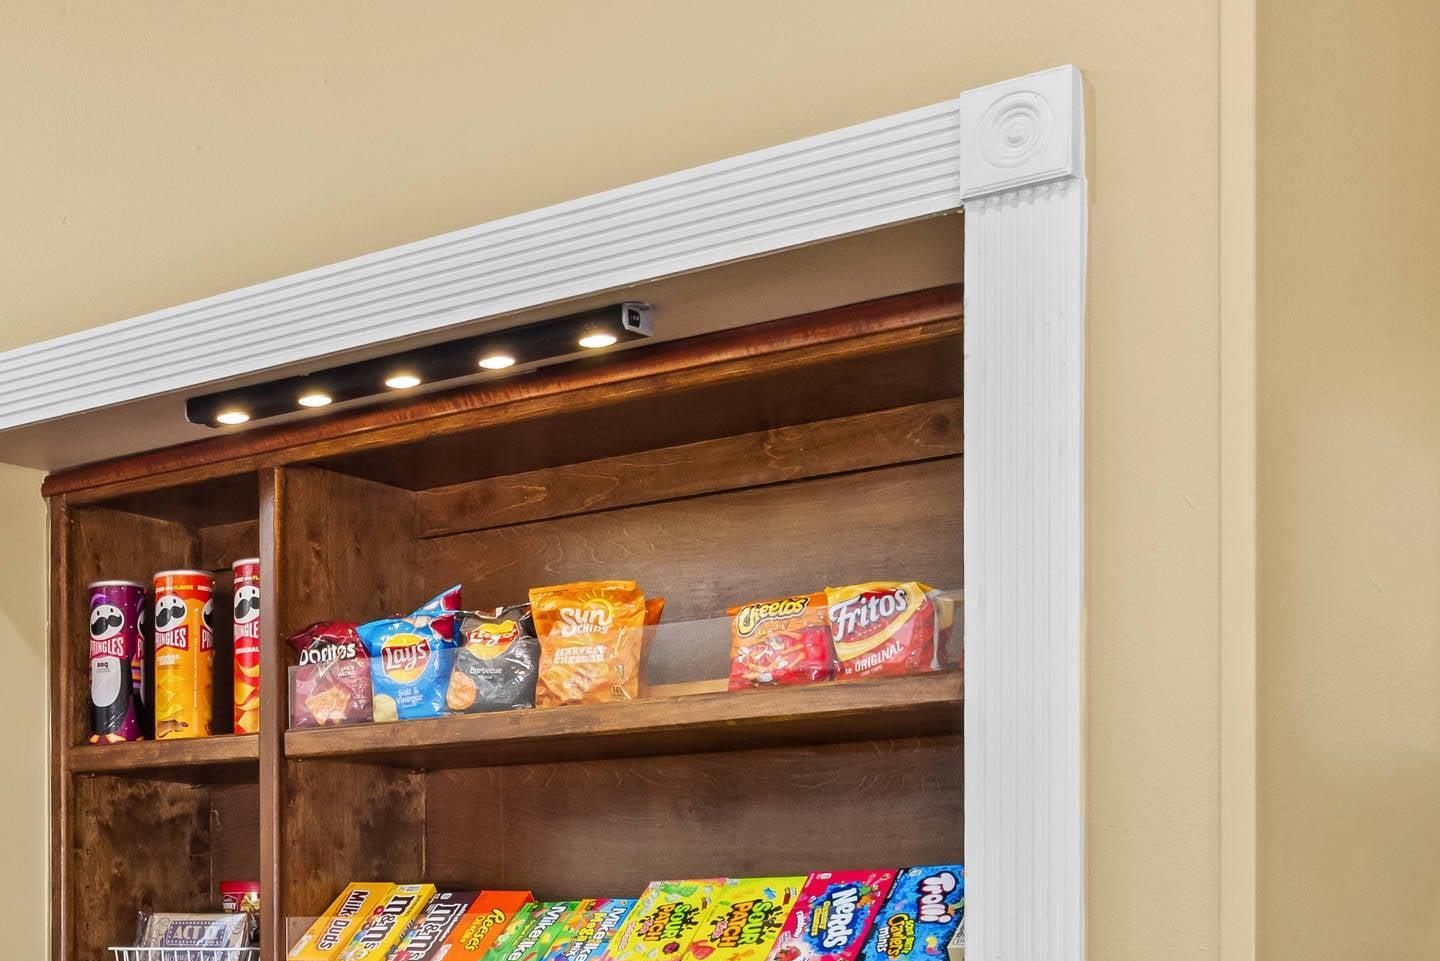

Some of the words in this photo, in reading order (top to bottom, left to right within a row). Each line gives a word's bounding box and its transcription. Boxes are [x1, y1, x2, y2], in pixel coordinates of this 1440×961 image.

[560, 608, 612, 637] Sun
[573, 624, 609, 635] CHIPS
[739, 598, 809, 634] Cheetos
[829, 588, 907, 641] Fritos
[299, 643, 356, 666] Doritos
[385, 643, 427, 671] Lay's
[556, 646, 605, 657] HARVEST
[854, 641, 904, 672] ORIGINAL
[469, 666, 502, 674] Barbecue
[396, 694, 423, 704] Vinegar
[398, 688, 412, 697] Salt
[338, 890, 370, 917] Milk
[919, 872, 956, 924] Trolli
[173, 925, 202, 940] ACT
[319, 918, 351, 951] Duds
[464, 908, 505, 952] Reese's
[529, 906, 567, 939] Mike
[592, 907, 626, 940] Mike
[644, 903, 676, 941] PATCH
[662, 903, 692, 939] SOUR
[718, 901, 754, 948] PATCH
[738, 901, 773, 945] SOUR
[887, 914, 910, 959] Crawlers
[876, 926, 890, 953] minis
